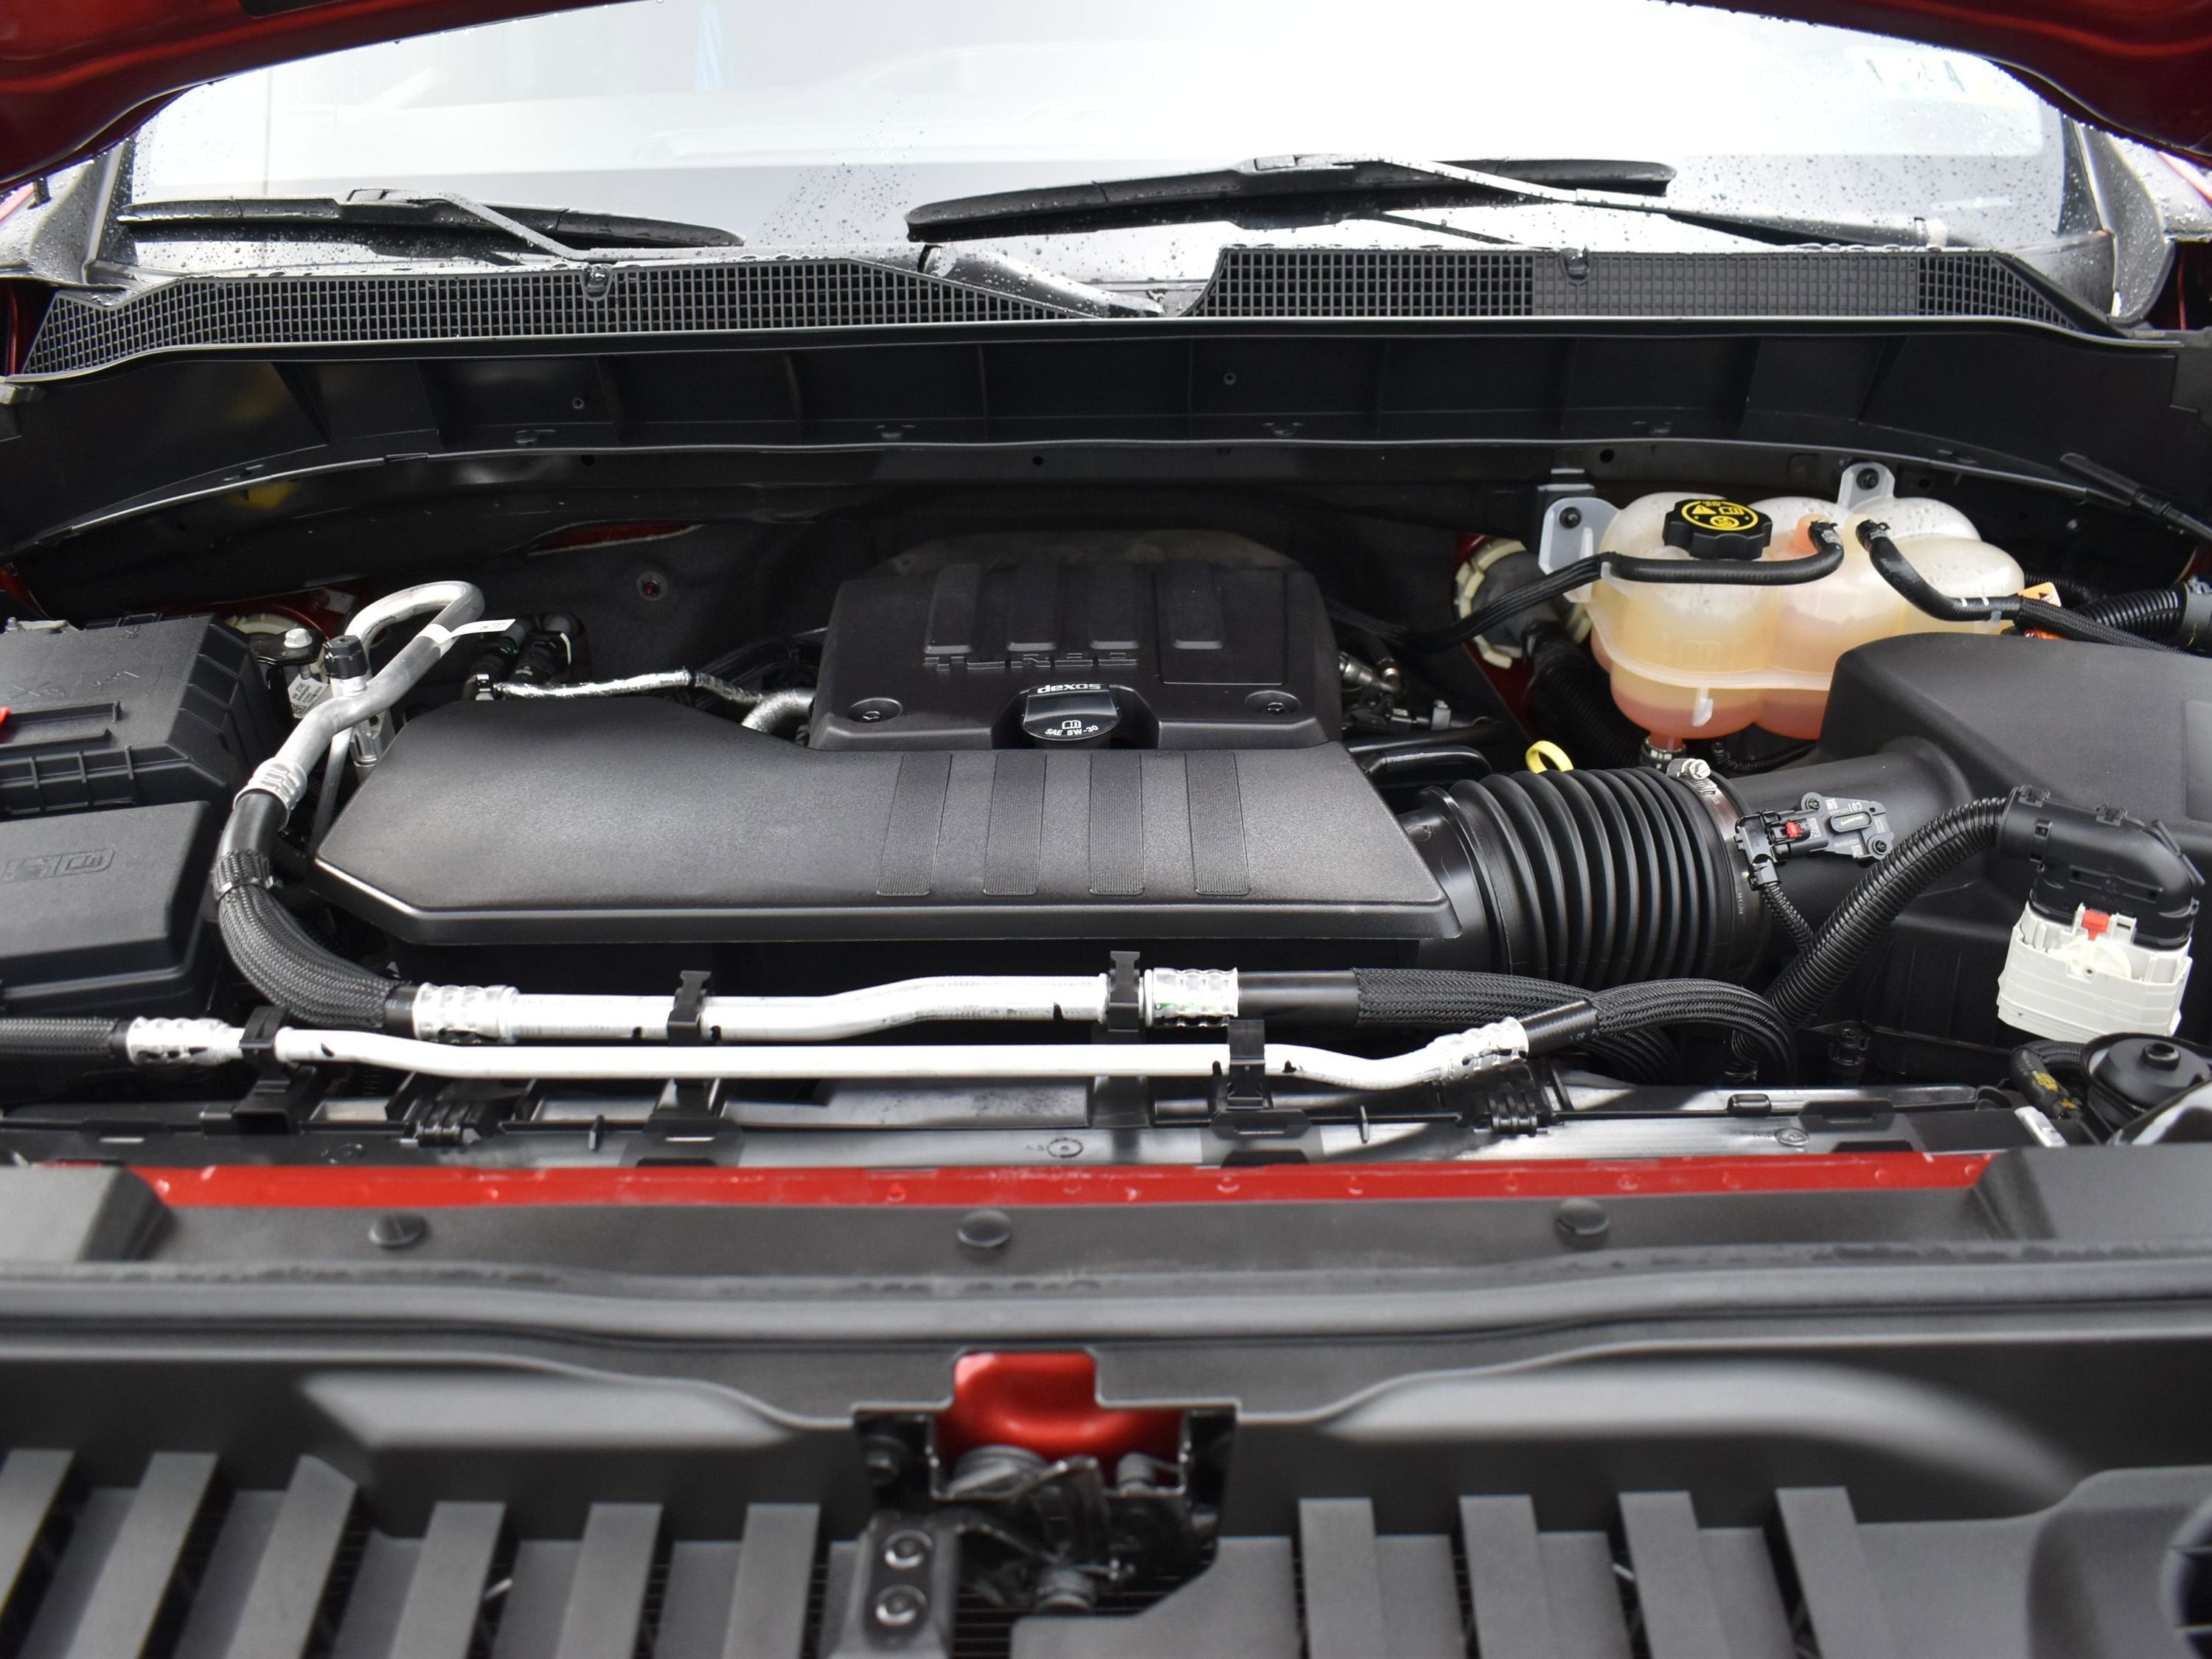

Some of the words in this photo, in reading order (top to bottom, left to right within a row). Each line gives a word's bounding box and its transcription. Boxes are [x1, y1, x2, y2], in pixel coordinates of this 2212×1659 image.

[1037, 684, 1102, 694] dexos
[1045, 728, 1063, 736] SAE
[1066, 725, 1099, 736] 5W-30
